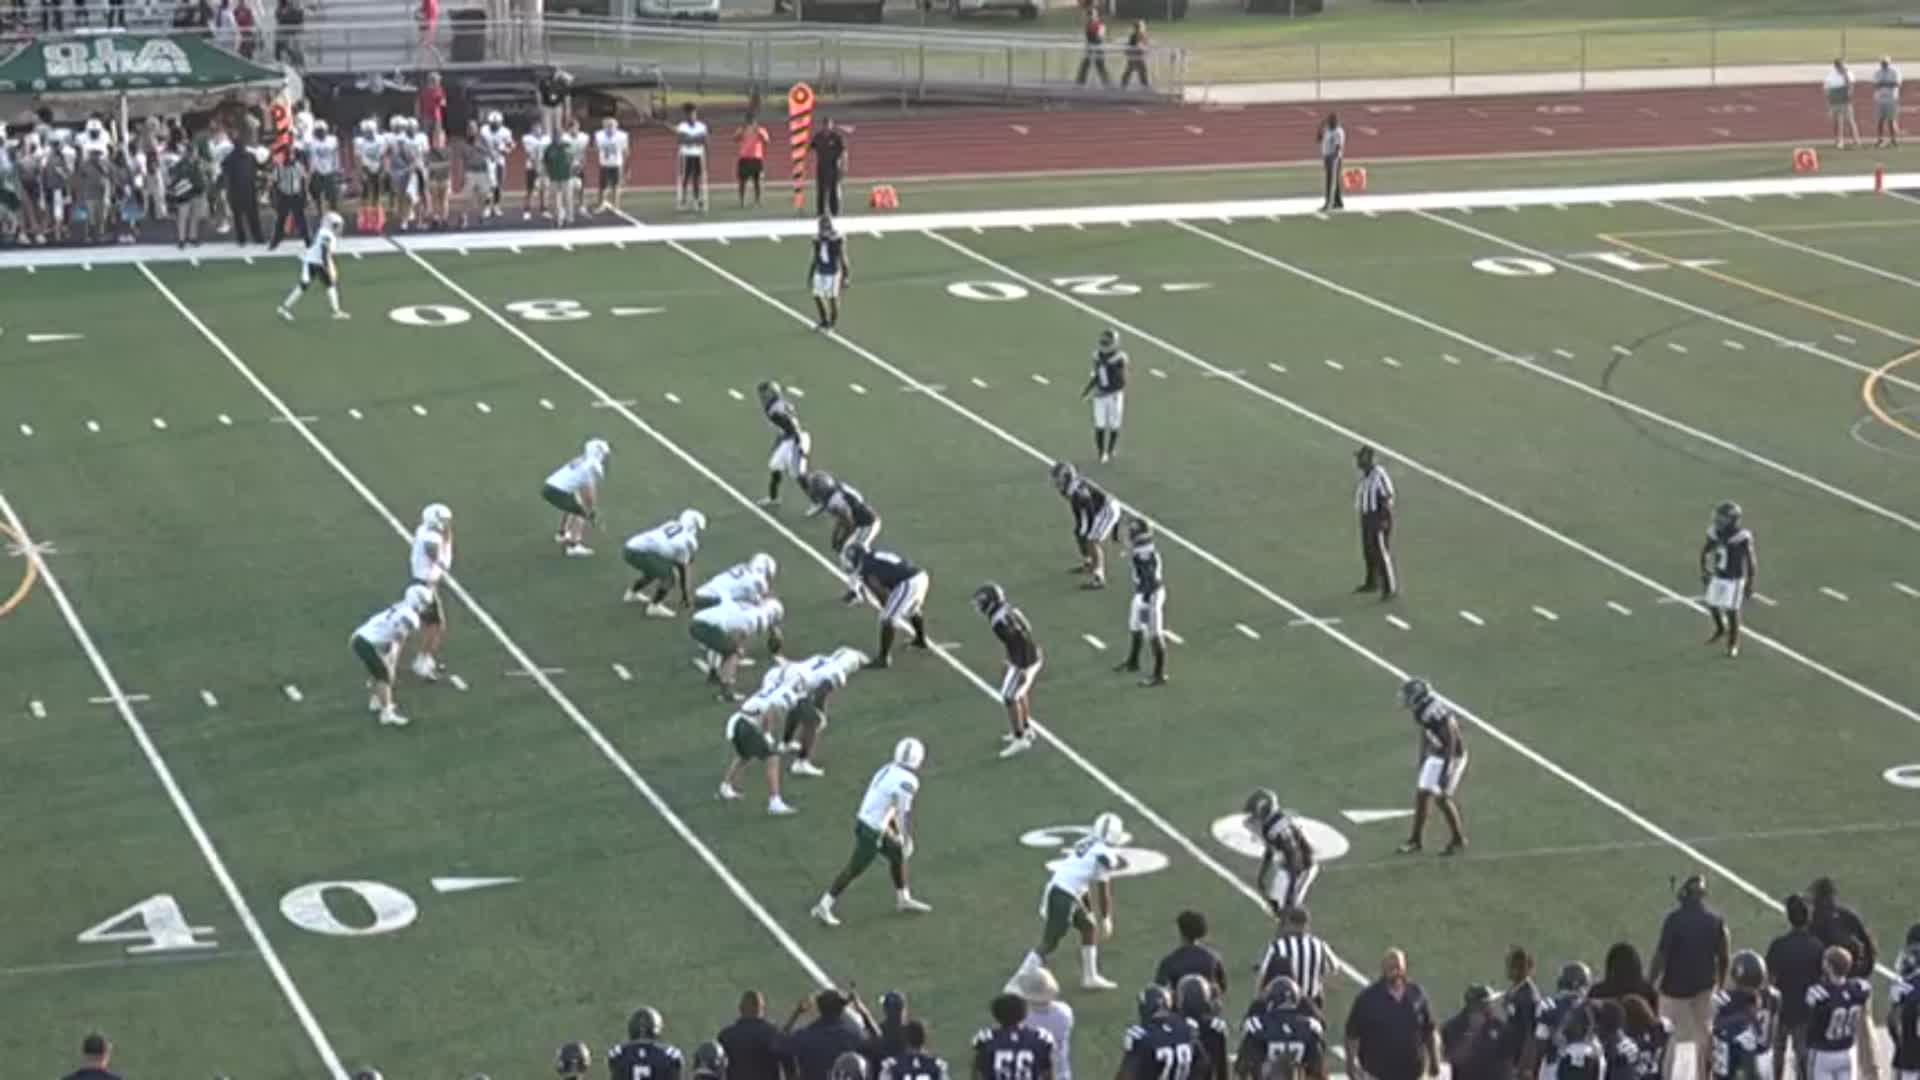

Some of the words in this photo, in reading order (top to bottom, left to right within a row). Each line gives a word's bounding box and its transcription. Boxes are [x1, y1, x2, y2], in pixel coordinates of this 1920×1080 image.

[946, 274, 1142, 301] 20
[388, 299, 592, 327] 30
[77, 880, 418, 955] 40
